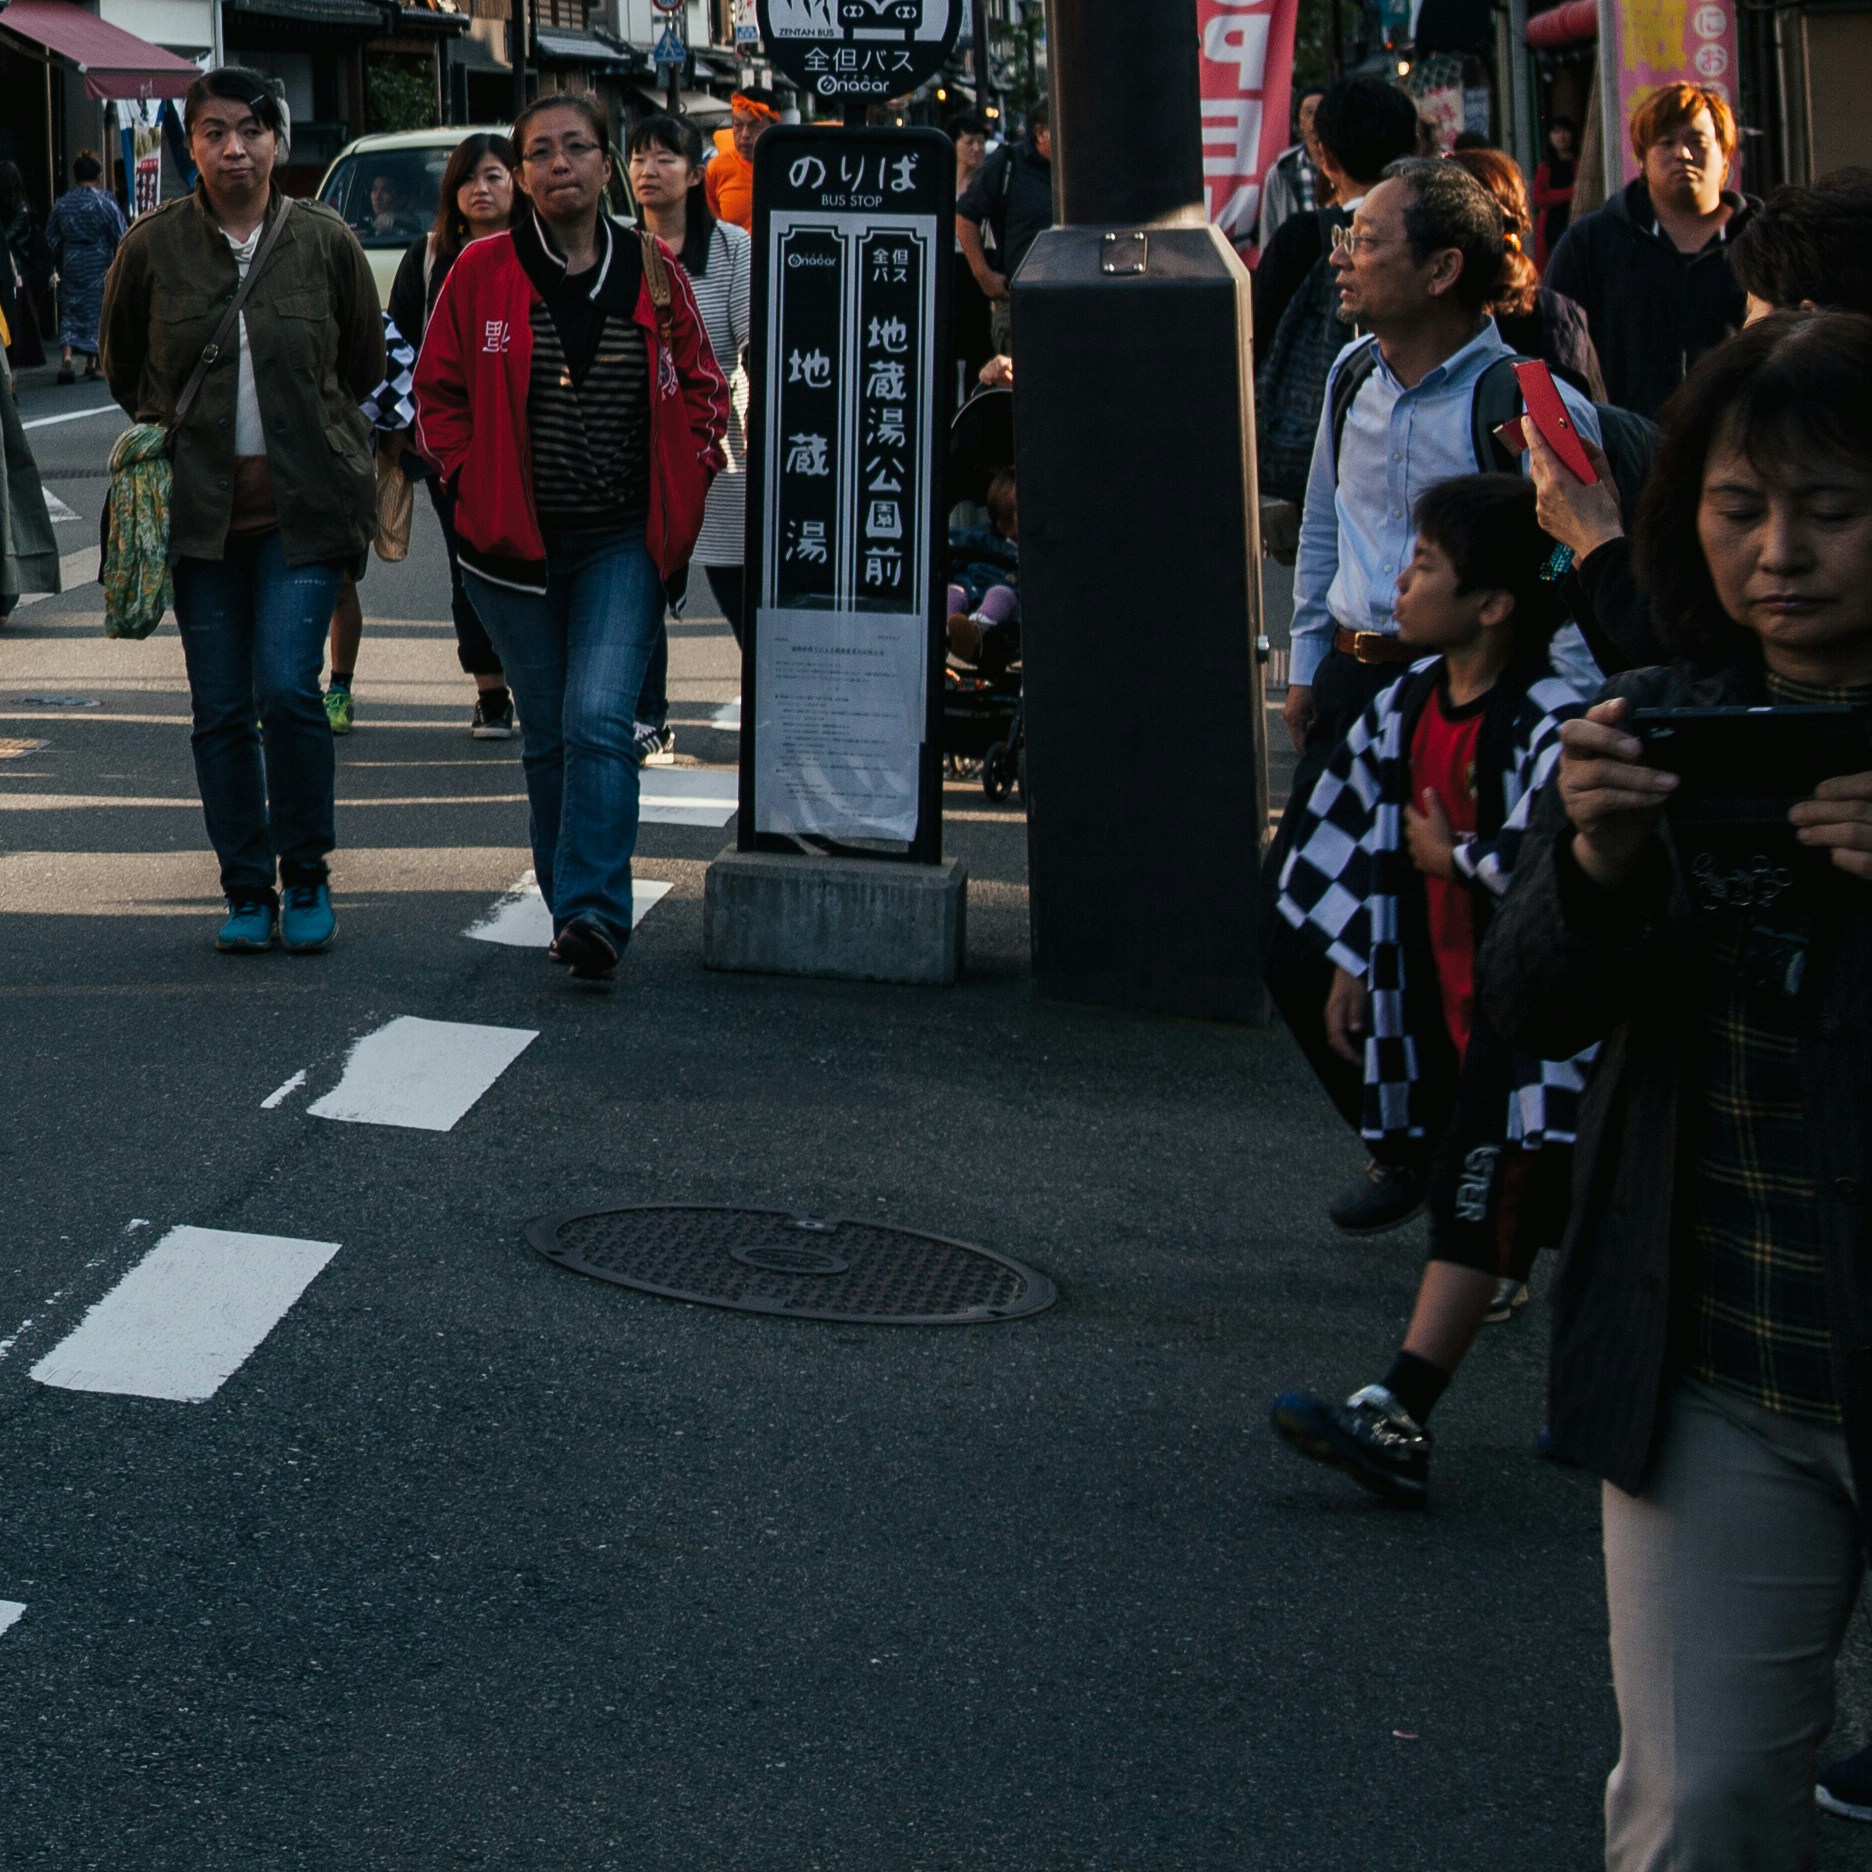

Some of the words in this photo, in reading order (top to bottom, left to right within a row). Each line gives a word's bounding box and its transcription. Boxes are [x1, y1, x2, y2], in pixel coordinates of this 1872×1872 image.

[779, 27, 813, 38] ZENTAN
[817, 27, 835, 38] BUS
[804, 46, 914, 72] 全但バス
[789, 154, 920, 193] のりば
[821, 194, 846, 208] BUS
[850, 194, 883, 209] STOP
[872, 248, 910, 266] 全但
[872, 266, 908, 283] バス
[785, 347, 832, 565] 地蔵湯
[865, 314, 910, 587] 地蔵湯公園前
